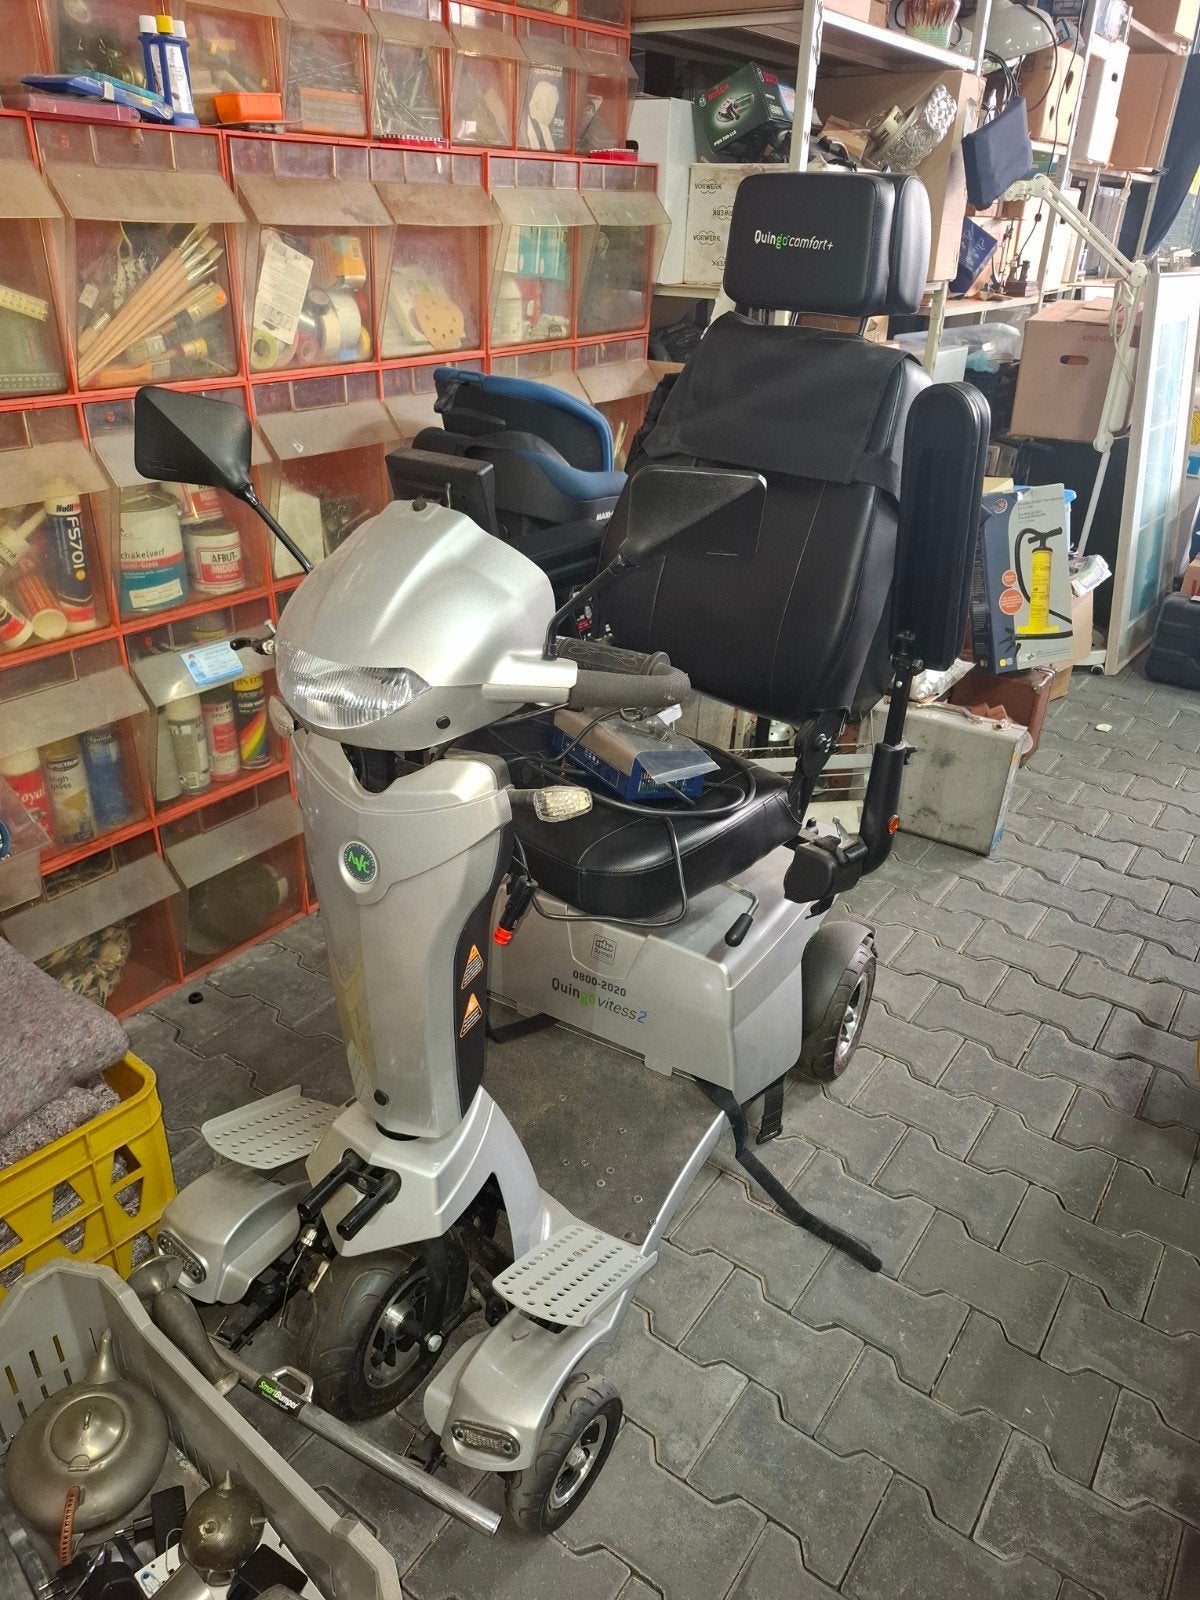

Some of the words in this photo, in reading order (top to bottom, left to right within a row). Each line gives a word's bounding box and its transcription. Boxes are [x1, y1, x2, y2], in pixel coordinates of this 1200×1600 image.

[706, 82, 730, 102] BOSCH
[694, 182, 722, 191] VORWERK
[693, 234, 721, 242] VORWERK
[120, 548, 166, 560] chakelverf
[20, 788, 45, 805] oyal
[572, 970, 627, 997] 0800-2020
